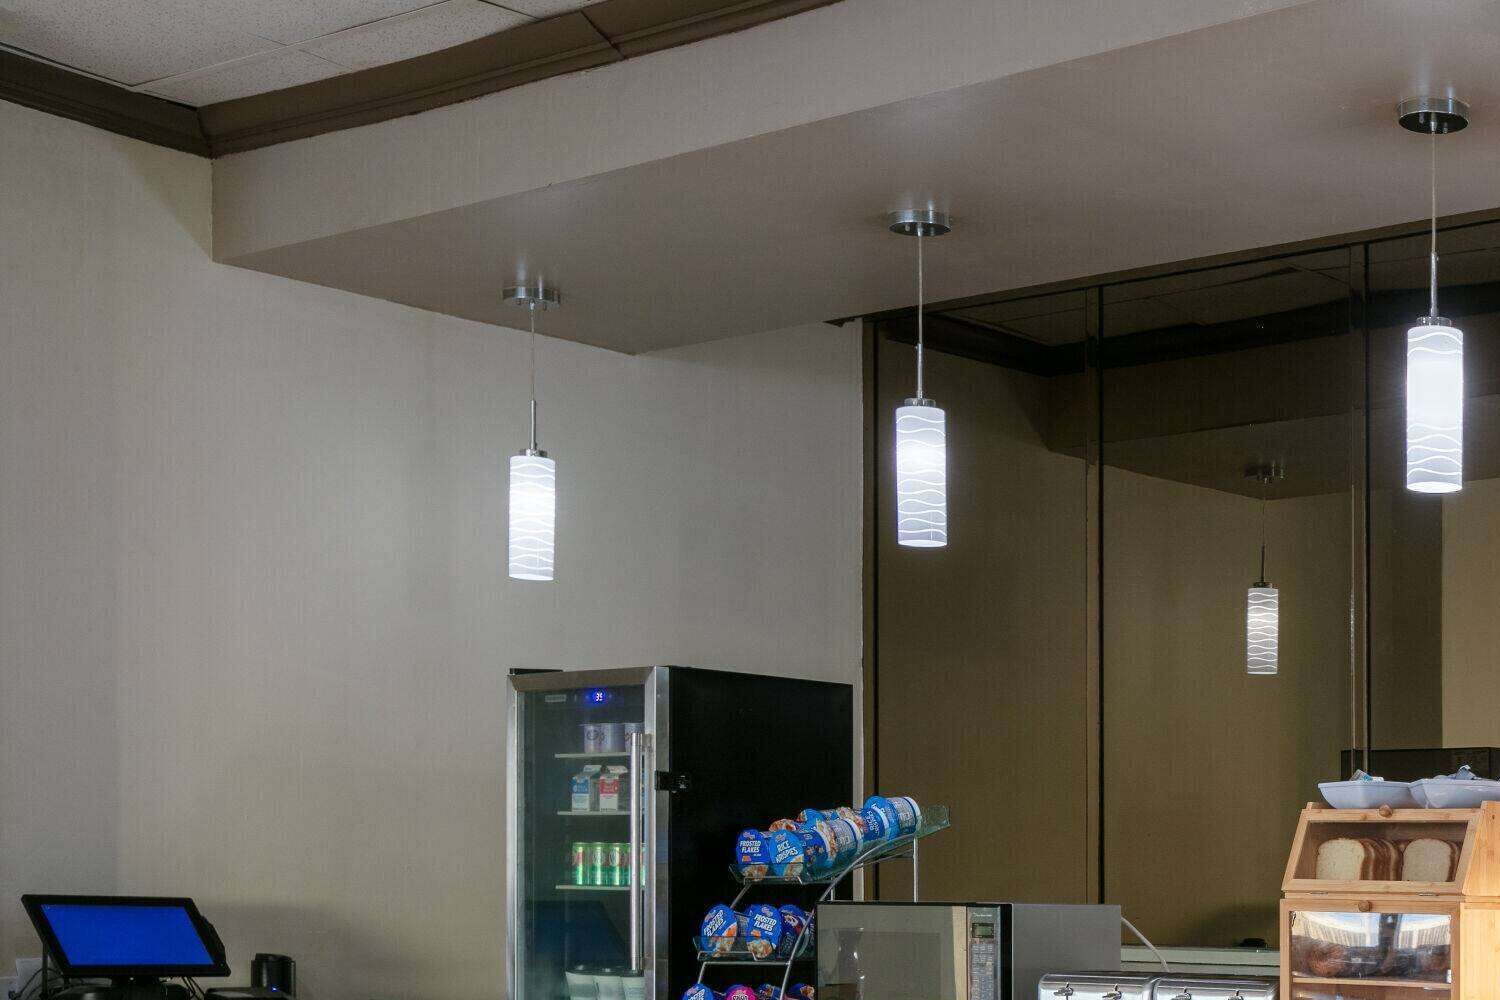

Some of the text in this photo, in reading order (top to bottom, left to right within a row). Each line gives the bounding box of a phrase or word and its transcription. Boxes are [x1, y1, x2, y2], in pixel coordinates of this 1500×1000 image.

[740, 840, 761, 848] FROSTED
[776, 840, 791, 852] RICE
[775, 847, 799, 863] KRISPIES
[753, 920, 774, 931] FLAKES
[754, 914, 777, 926] FROSTED
